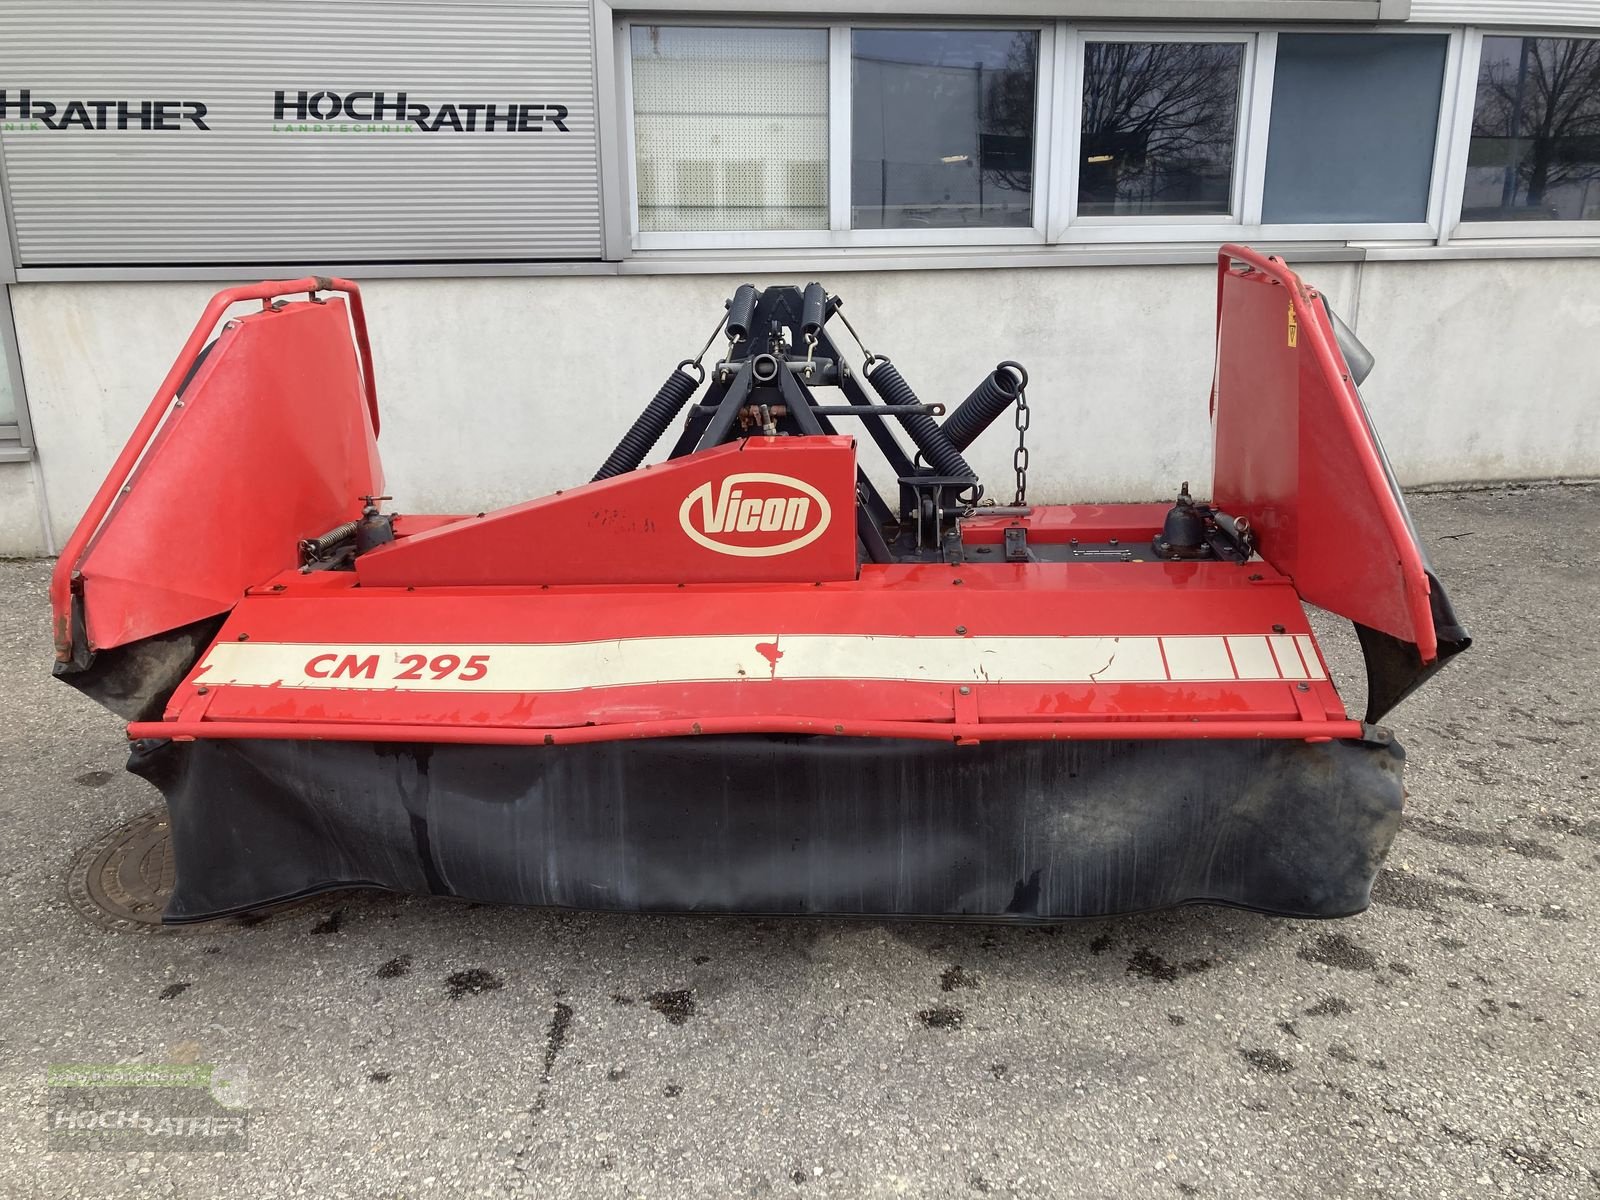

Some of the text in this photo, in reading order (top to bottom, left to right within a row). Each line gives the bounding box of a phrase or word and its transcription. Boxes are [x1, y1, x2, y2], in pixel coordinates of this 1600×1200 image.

[272, 124, 414, 133] LANDTECHNIK
[273, 90, 571, 132] HOCHRATHER
[694, 478, 814, 537] Vicon
[303, 653, 490, 681] CM 295
